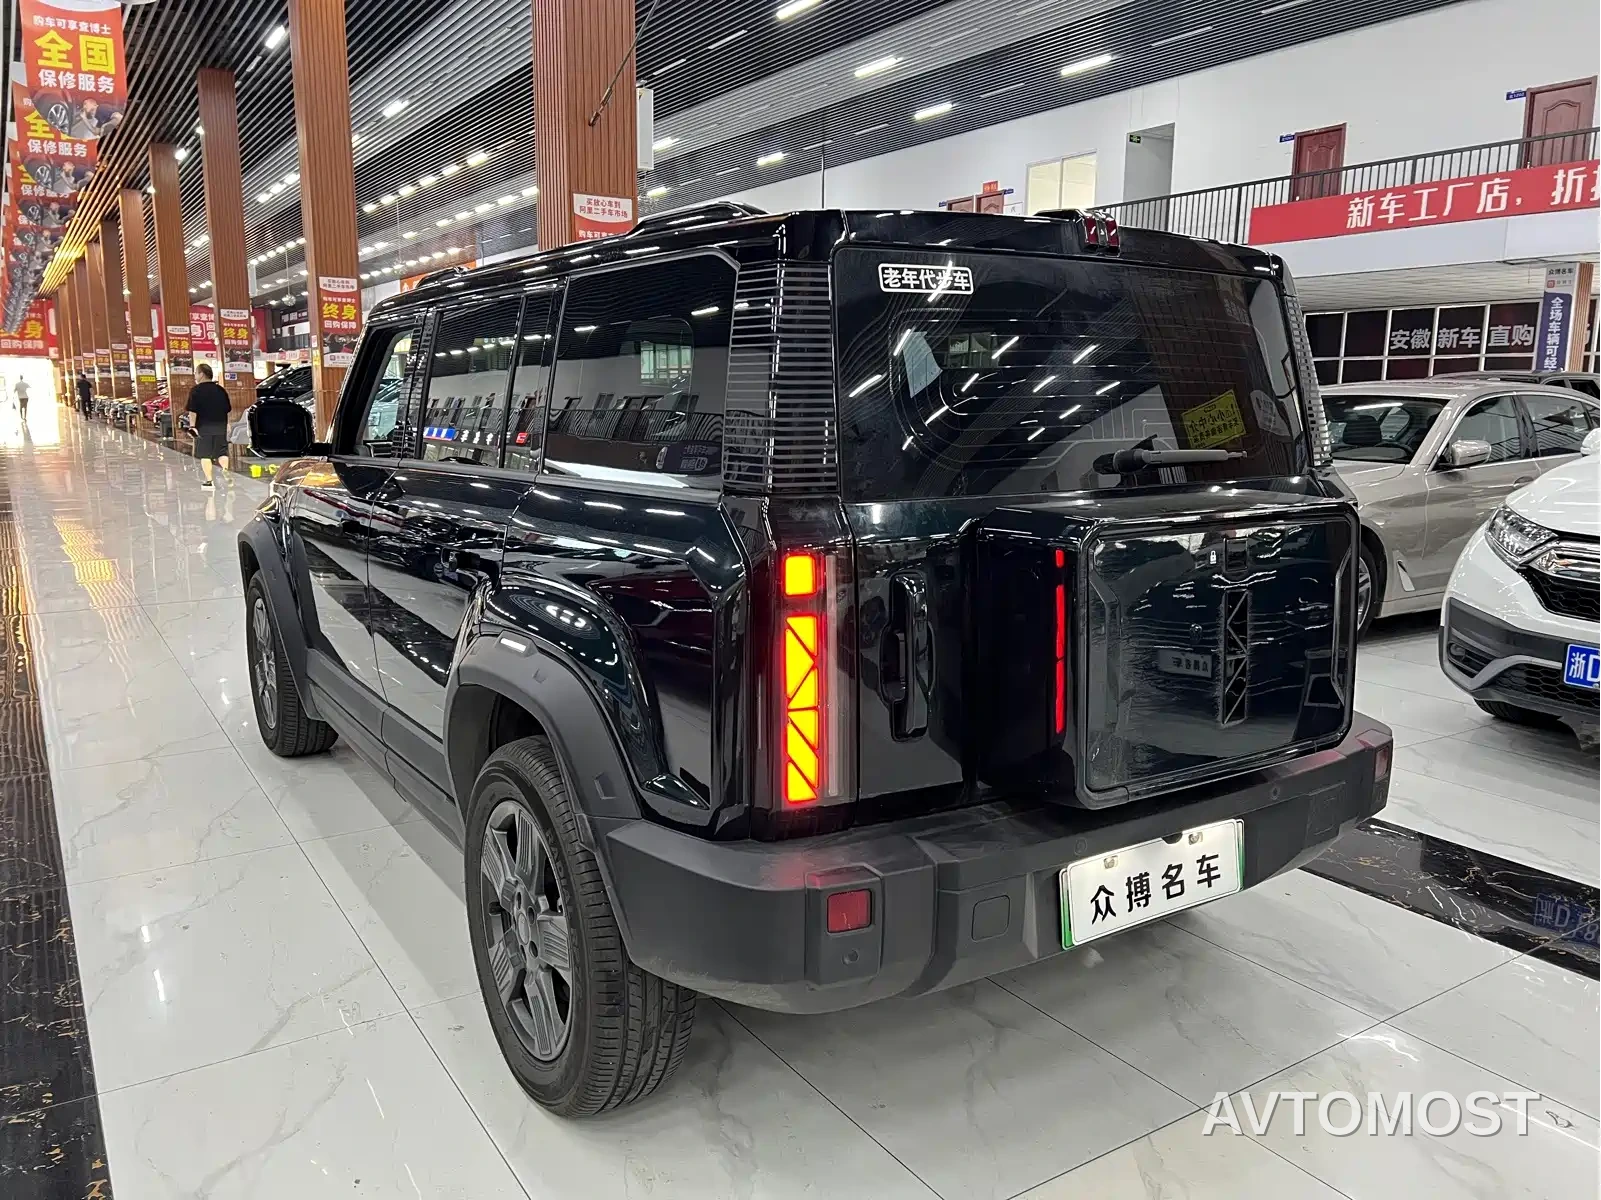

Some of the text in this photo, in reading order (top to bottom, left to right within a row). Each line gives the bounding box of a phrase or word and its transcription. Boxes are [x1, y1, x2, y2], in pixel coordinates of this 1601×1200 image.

[33, 15, 111, 35] 购车可享查博士
[34, 29, 116, 74] 全国
[38, 69, 114, 93] 保修服务
[28, 139, 87, 157] 保修服务
[580, 206, 628, 218] 阿里二手车市场
[883, 268, 970, 290] 老年代步车
[323, 303, 356, 320] 终身
[223, 327, 248, 339] 终身
[324, 320, 357, 329] 回购保障
[1090, 854, 1221, 925] 众博名车
